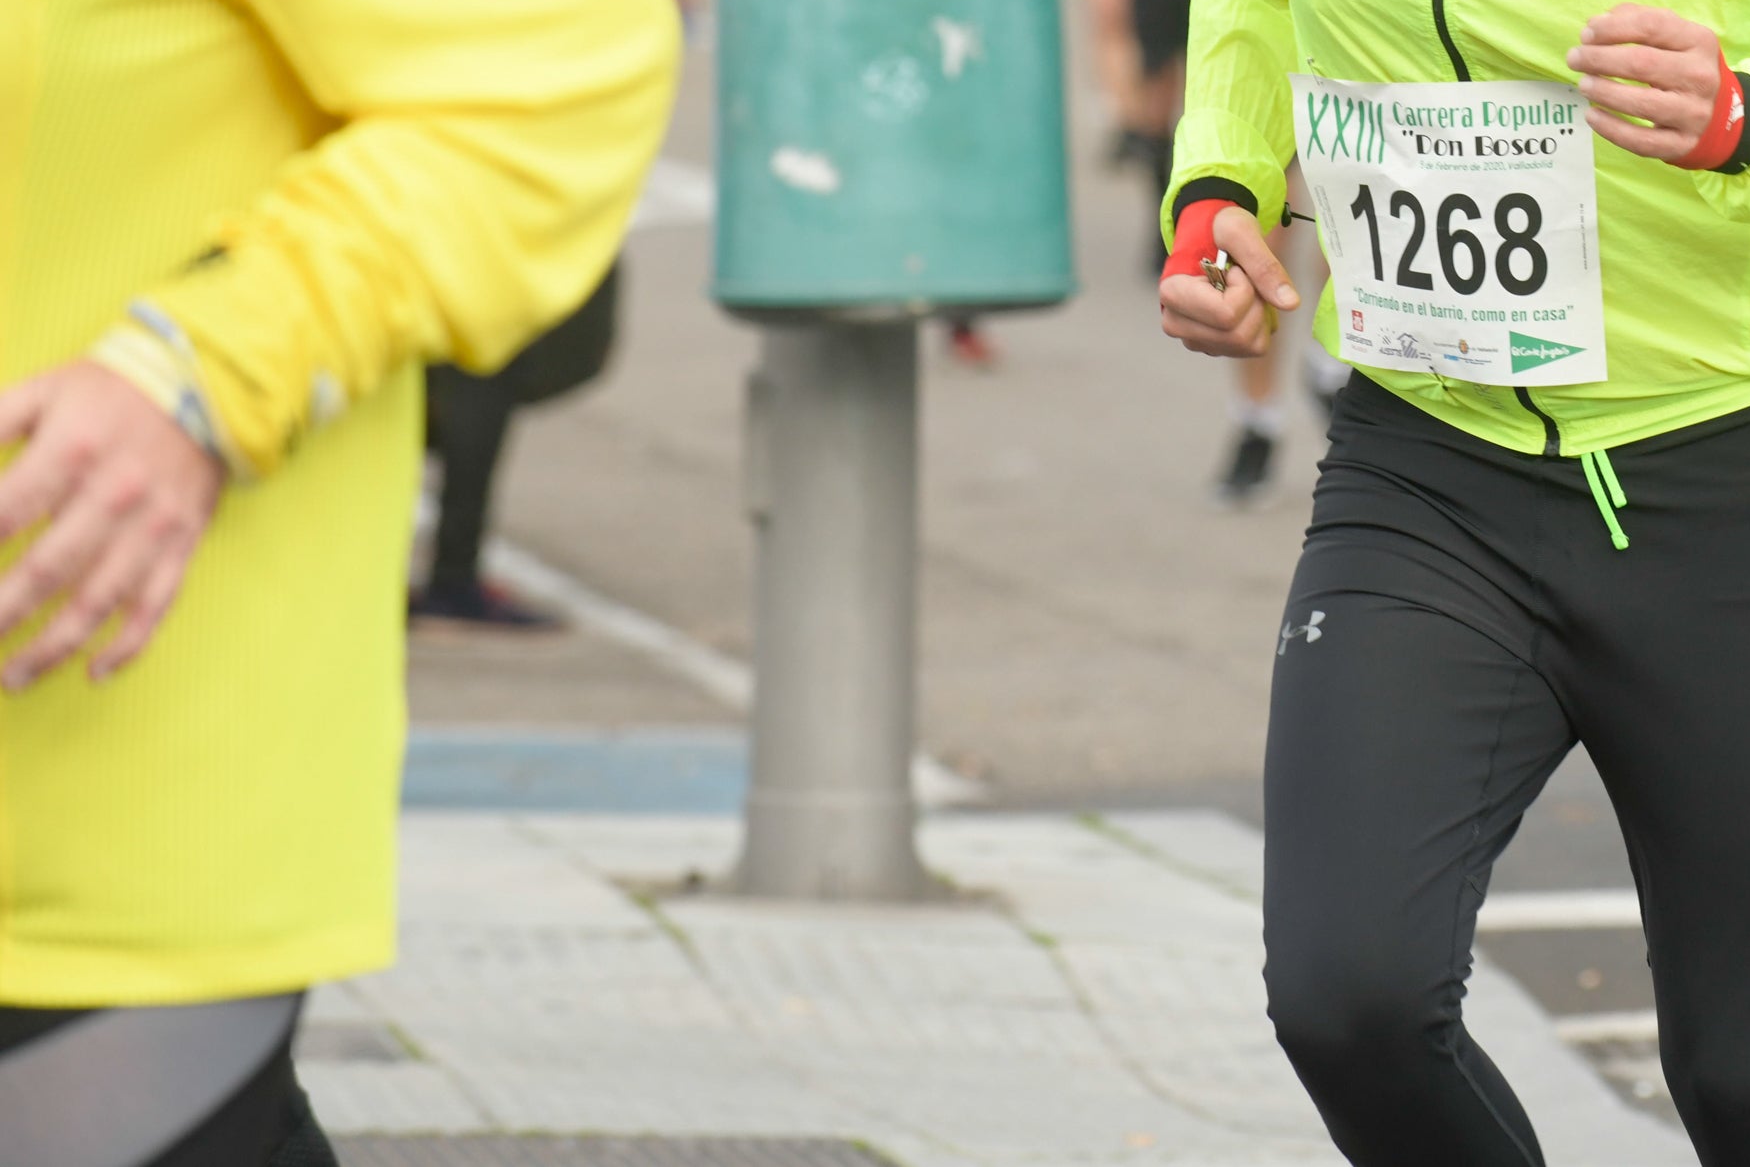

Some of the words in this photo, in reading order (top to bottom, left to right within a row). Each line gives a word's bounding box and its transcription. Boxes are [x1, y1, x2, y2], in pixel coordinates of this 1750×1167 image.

[1307, 91, 1386, 165] XXIII
[1392, 100, 1474, 129] Carrera
[1482, 99, 1578, 131] Popular
[1350, 184, 1548, 296] 1268
[1402, 301, 1415, 315] en
[1418, 302, 1427, 316] el
[1471, 309, 1507, 322] como
[1511, 309, 1528, 322] en
